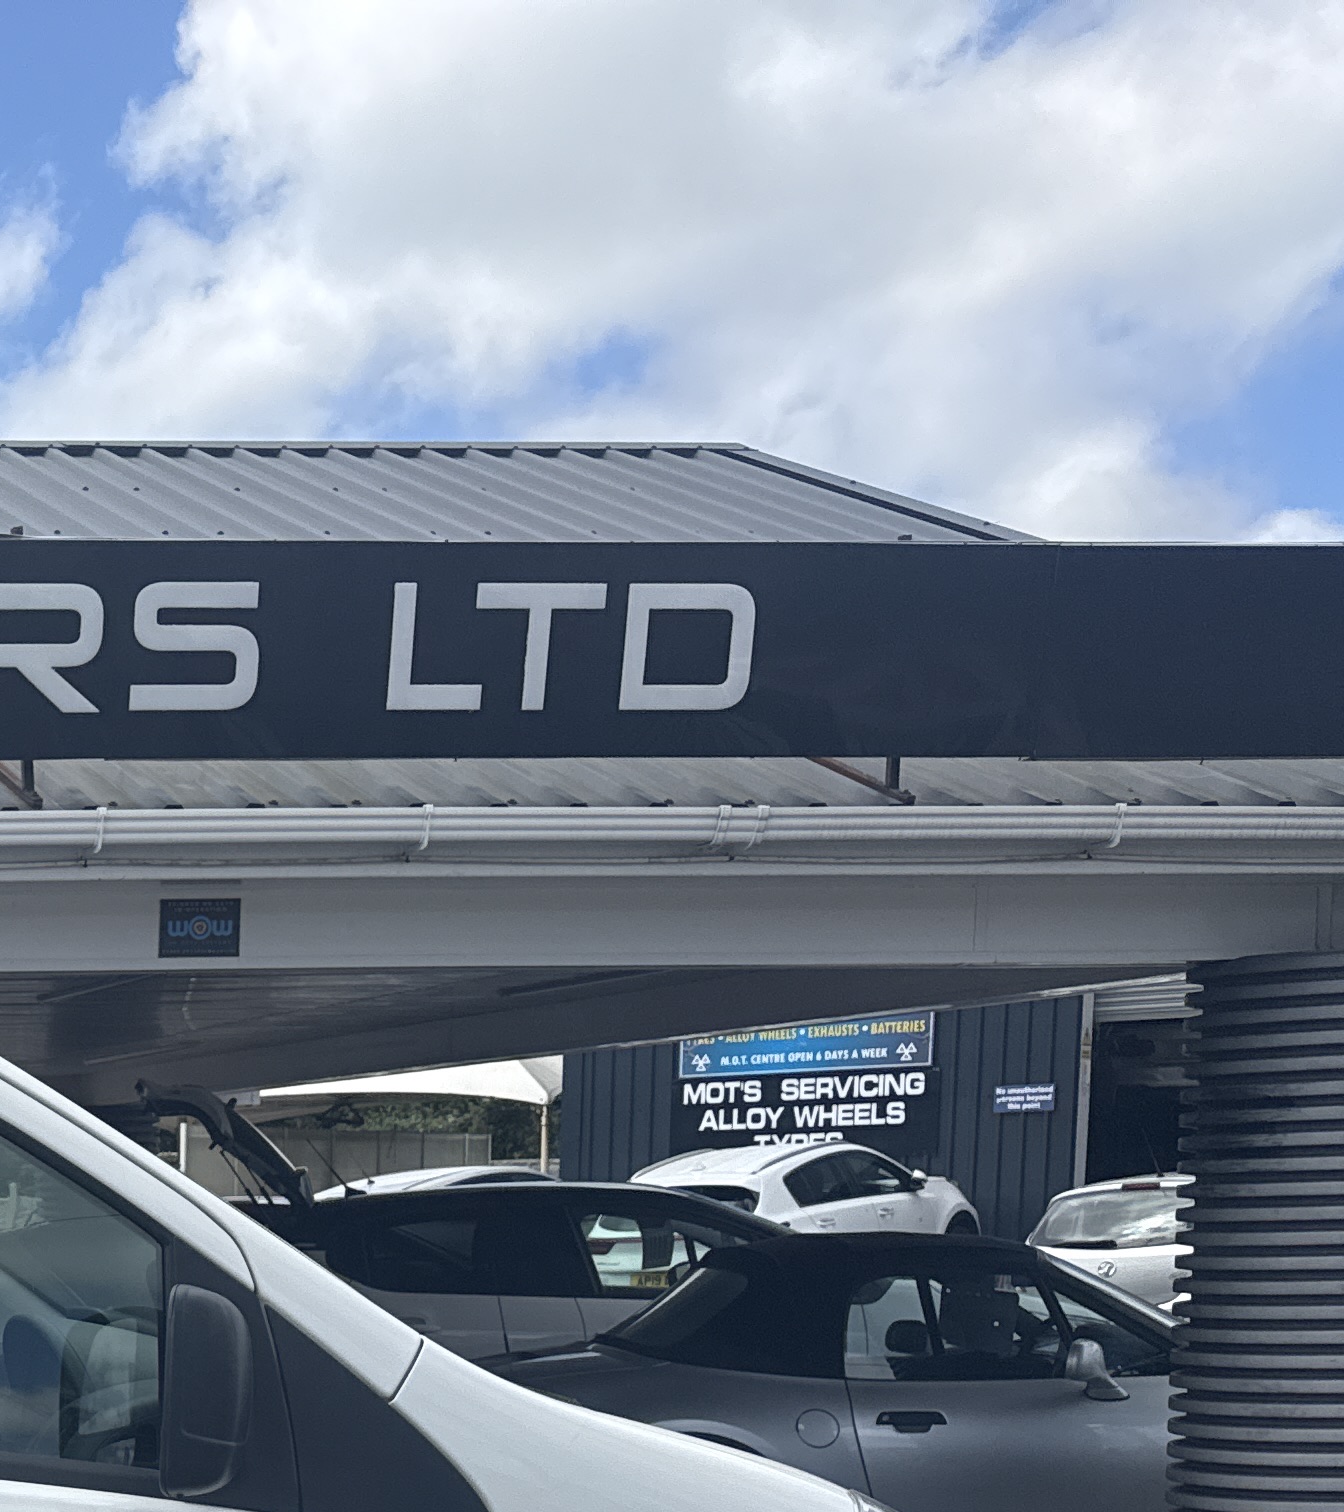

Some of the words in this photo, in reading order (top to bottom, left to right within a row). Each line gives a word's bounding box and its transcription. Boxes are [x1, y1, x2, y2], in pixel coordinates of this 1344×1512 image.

[385, 581, 758, 712] LTD
[759, 1028, 797, 1041] WHEELS
[808, 1023, 860, 1038] EXHAUSTS
[870, 1019, 926, 1035] BATTERIES
[720, 1055, 748, 1066] M.O.T.
[750, 1053, 785, 1065] CENTRE
[787, 1051, 813, 1062] OPEN
[815, 1051, 822, 1061] 6
[824, 1049, 849, 1061] DAYS
[851, 1049, 859, 1059] A
[861, 1047, 888, 1059] WEEK
[682, 1080, 762, 1105] MOT'S
[780, 1072, 926, 1101] SERVICING
[698, 1107, 784, 1131] ALLOY
[793, 1101, 906, 1128] WHEELS
